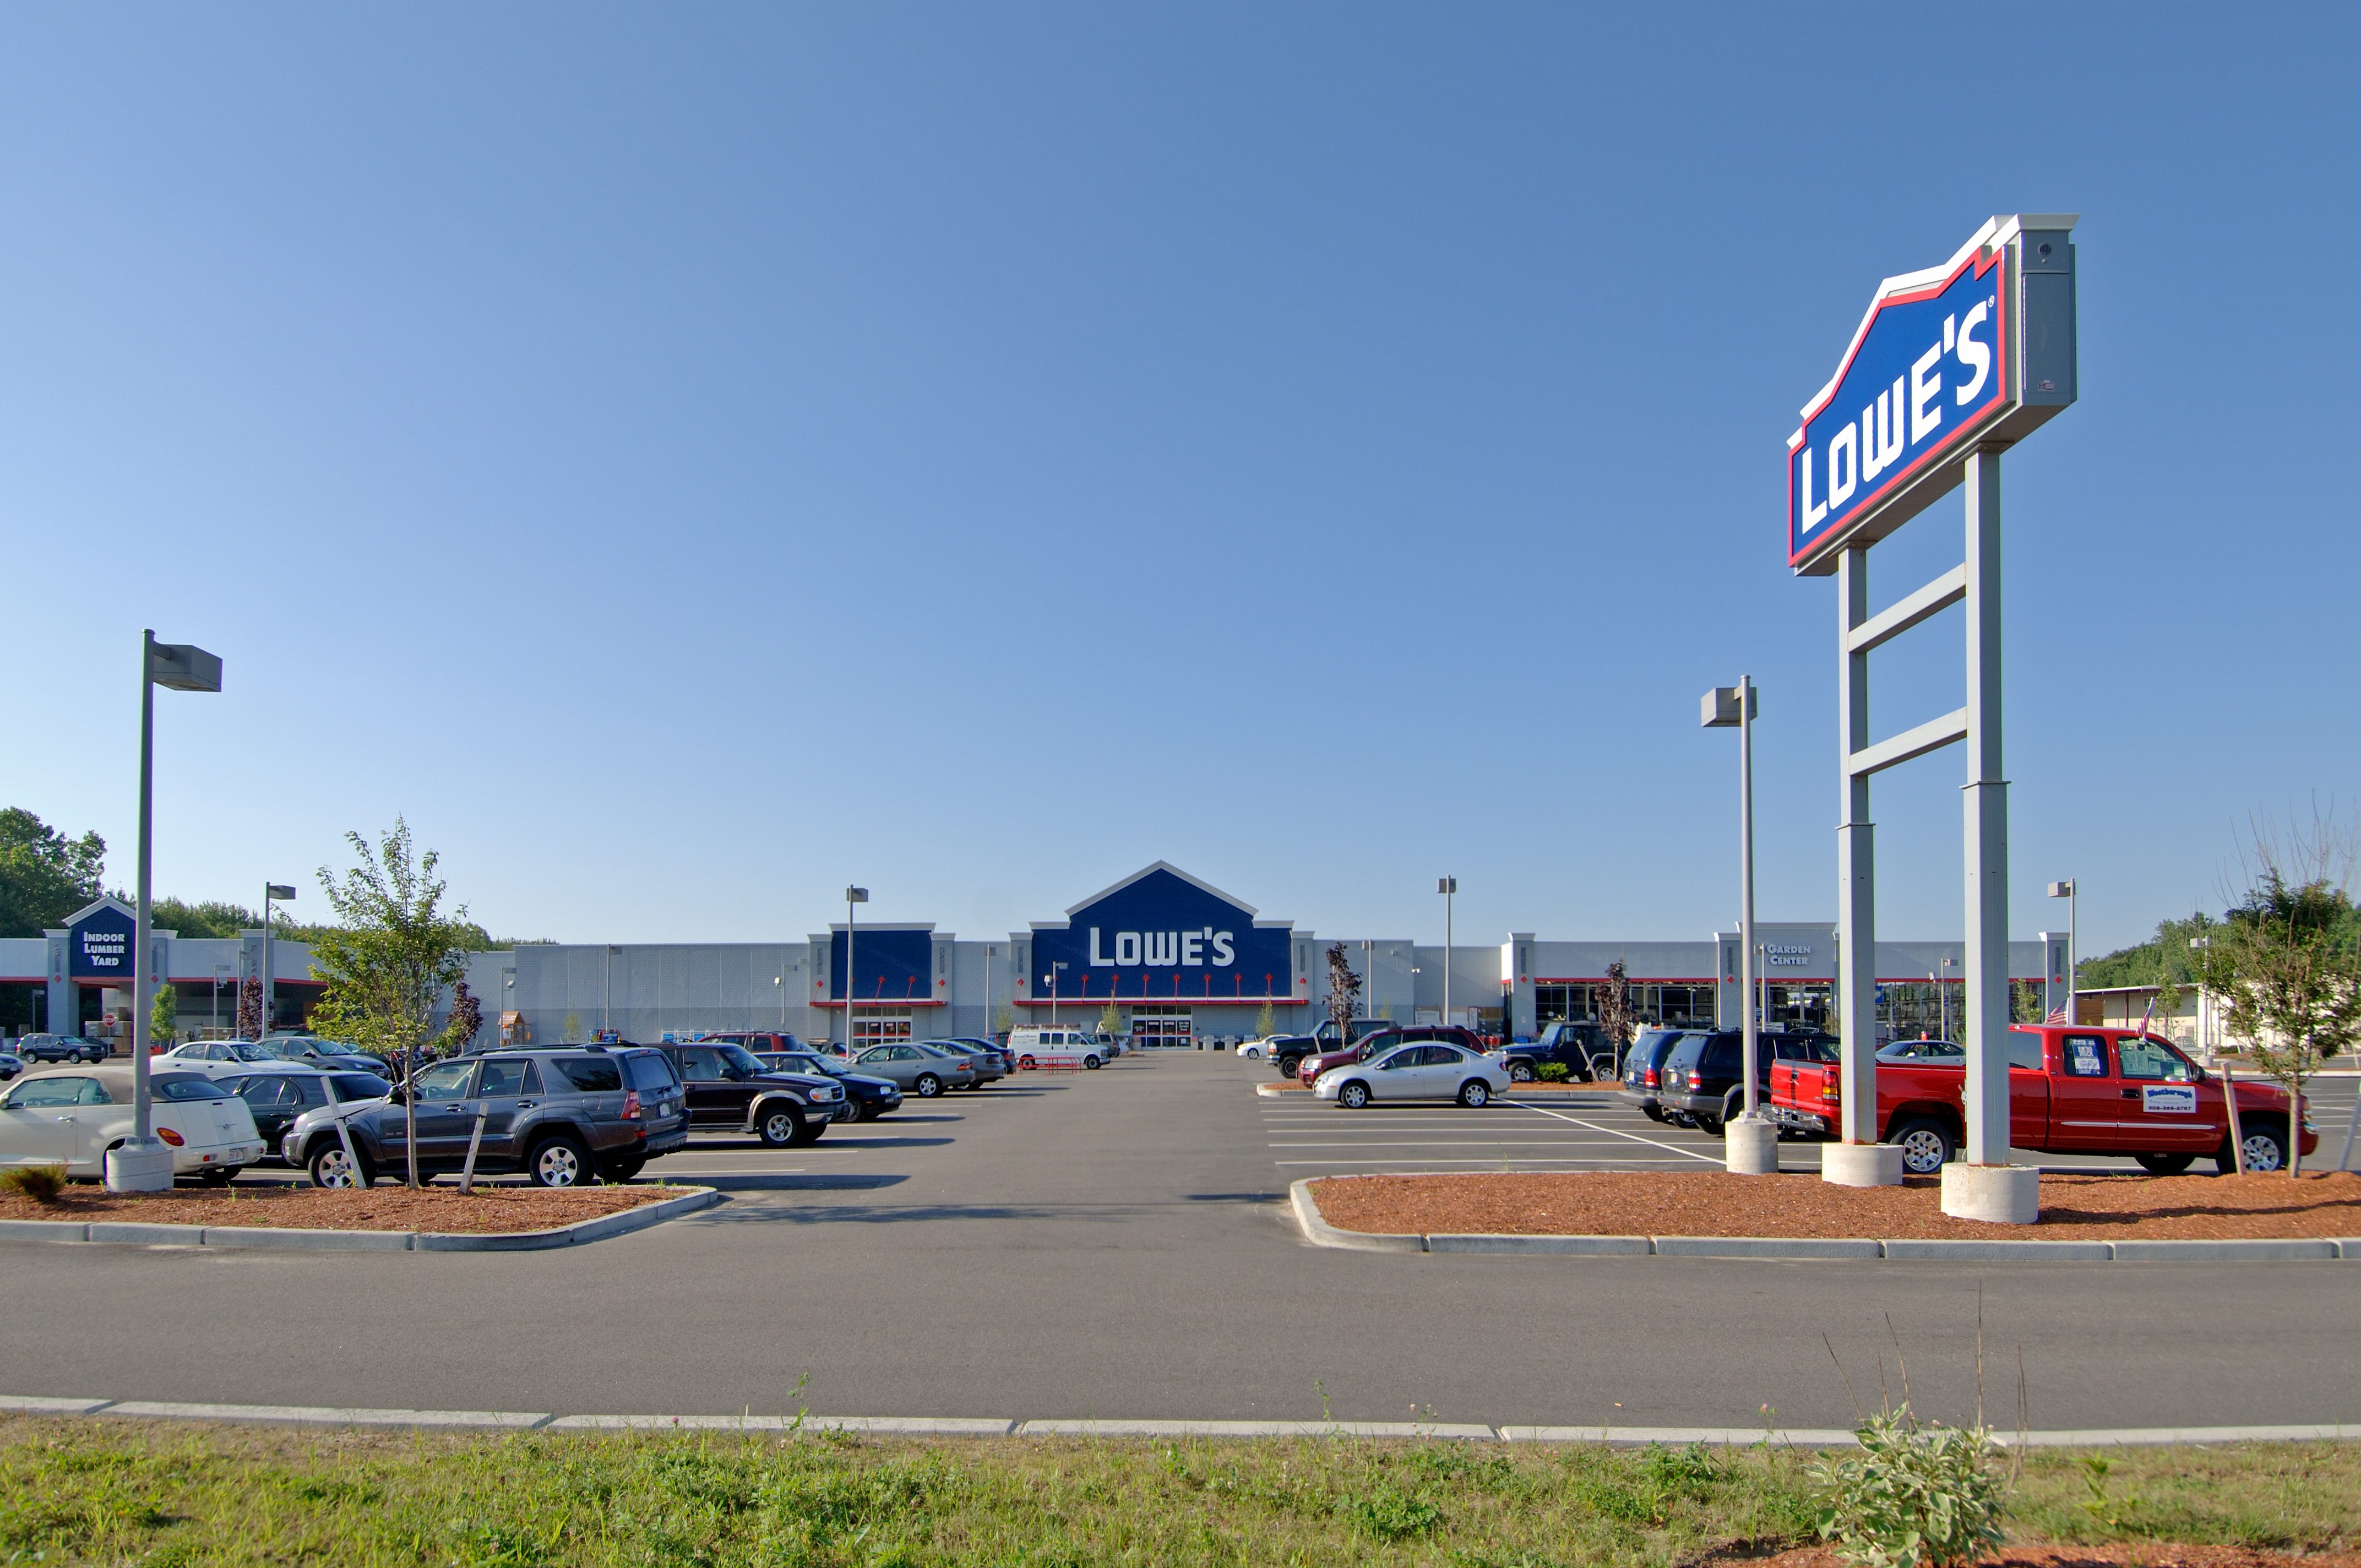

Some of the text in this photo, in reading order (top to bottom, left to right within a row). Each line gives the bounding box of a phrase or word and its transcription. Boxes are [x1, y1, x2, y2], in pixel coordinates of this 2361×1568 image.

[1802, 300, 1990, 534] LOWE'S
[84, 932, 125, 942] INDOOR
[84, 943, 125, 954] LUMBER
[1090, 927, 1235, 967] LOWE'S
[1766, 944, 1811, 954] GARDEN
[91, 955, 119, 966] YARD
[1769, 955, 1808, 965] CENTER
